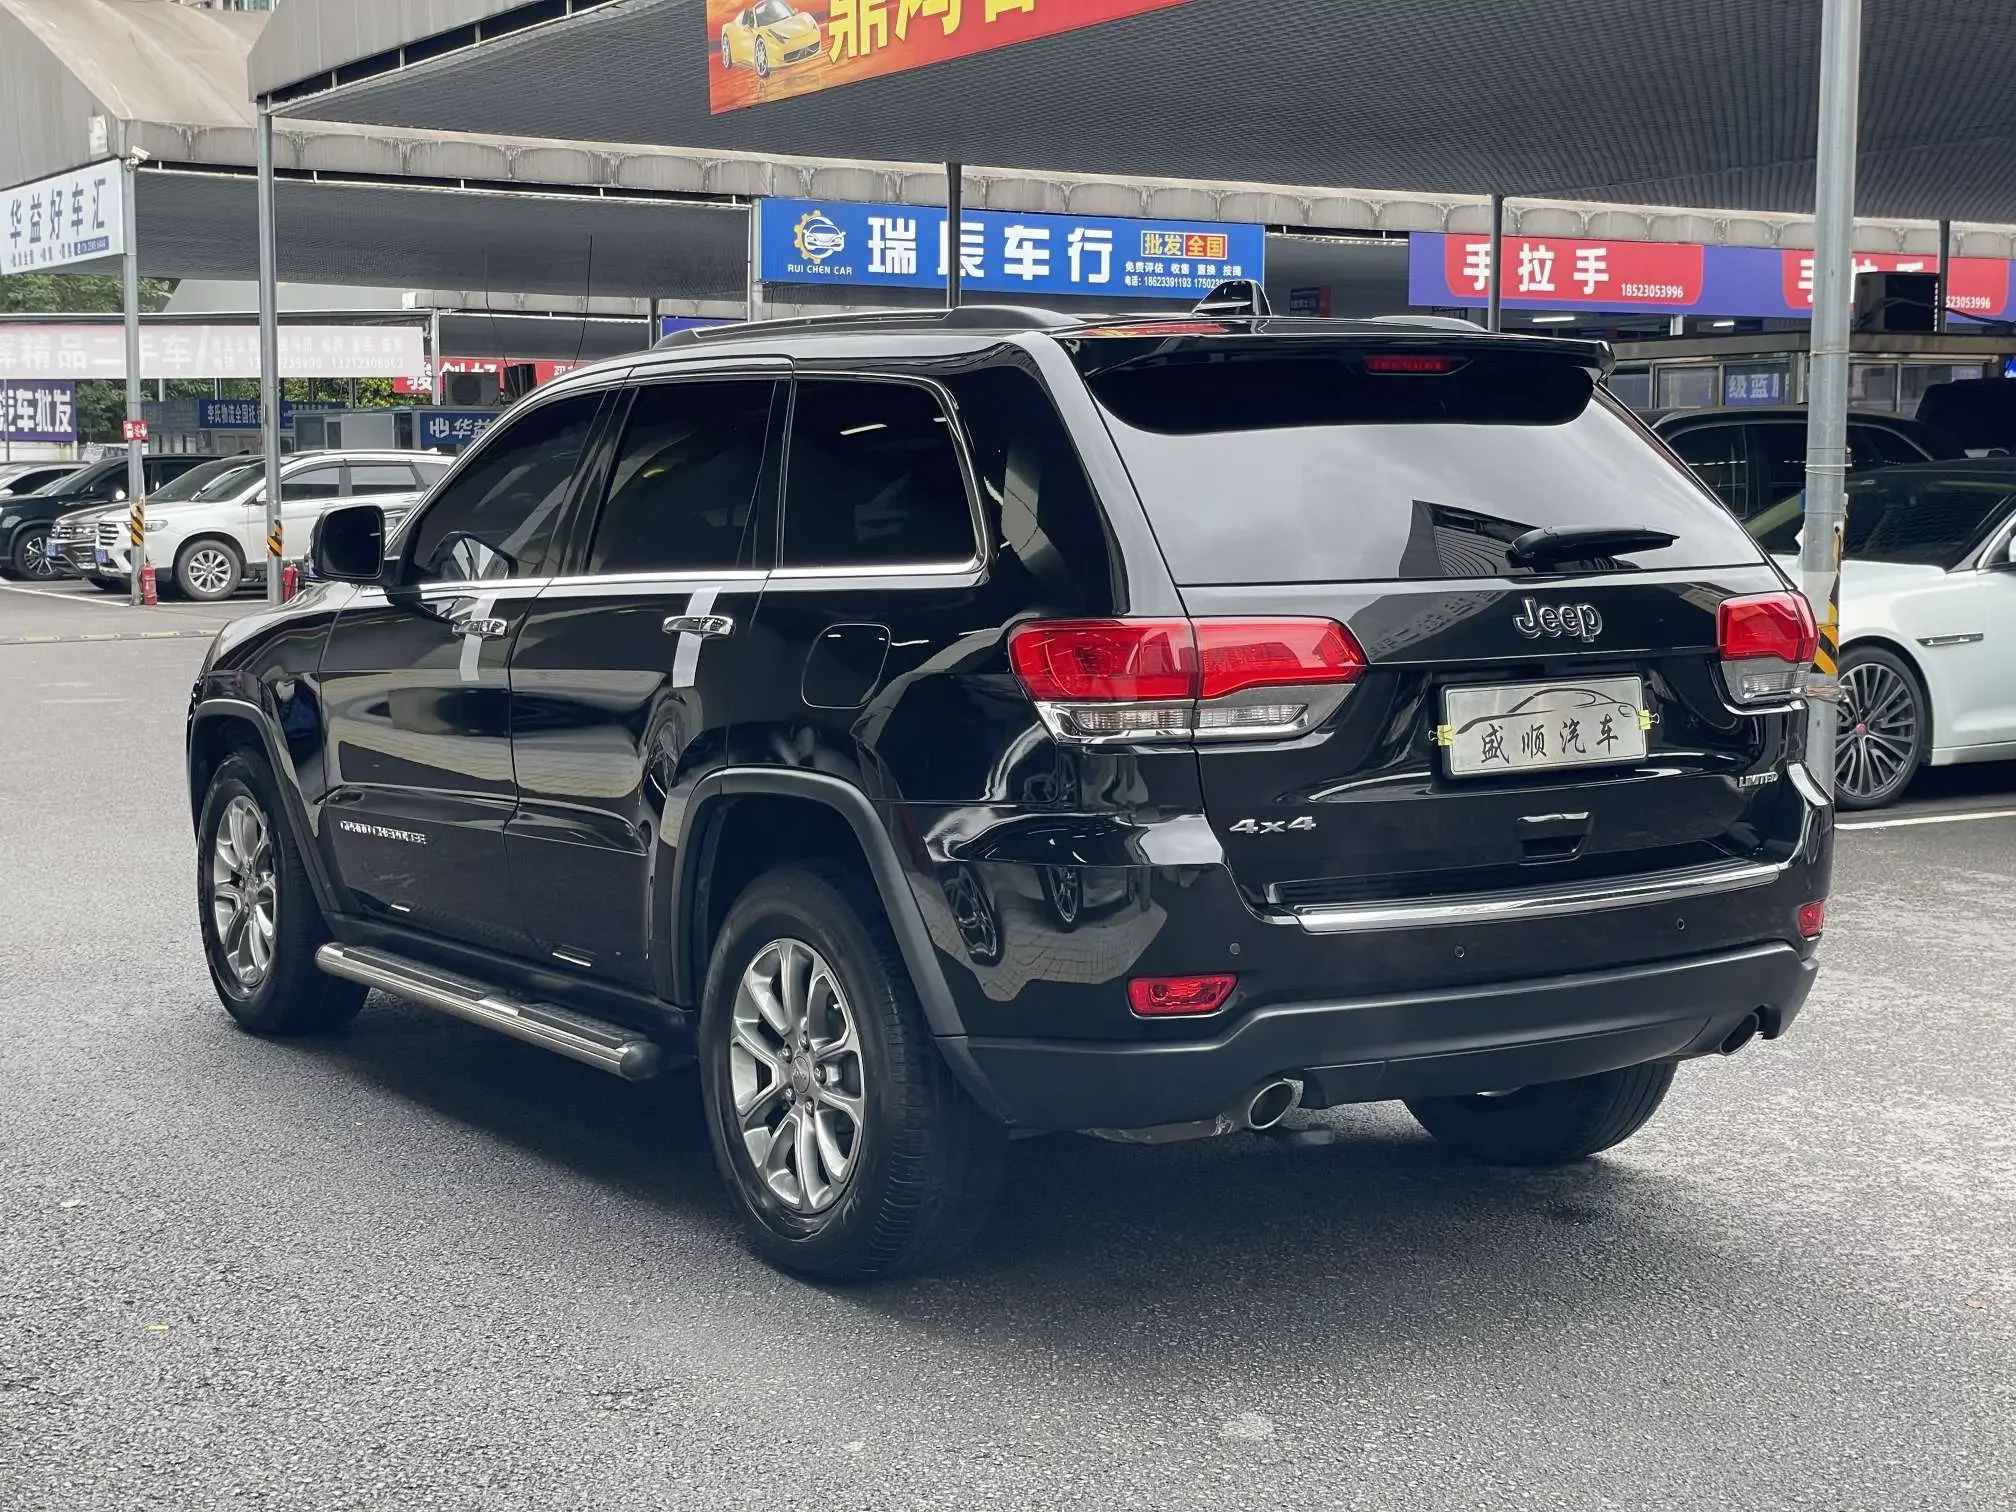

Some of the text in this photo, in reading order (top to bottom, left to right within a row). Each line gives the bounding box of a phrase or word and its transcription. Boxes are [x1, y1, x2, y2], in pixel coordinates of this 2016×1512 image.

[10, 178, 106, 249] 华益好车汇
[868, 216, 1113, 284] 瑞辰车行
[1144, 233, 1224, 257] 批发 全国
[788, 264, 853, 276] RUI CHEN CAR
[1145, 276, 1192, 288] 18623391193
[1463, 242, 1609, 295] 手拉手
[1620, 284, 1683, 299] 18523053996
[1512, 598, 1602, 642] Jeep
[1480, 714, 1619, 764] 盛顺汽车
[1229, 816, 1317, 834] 4x4
